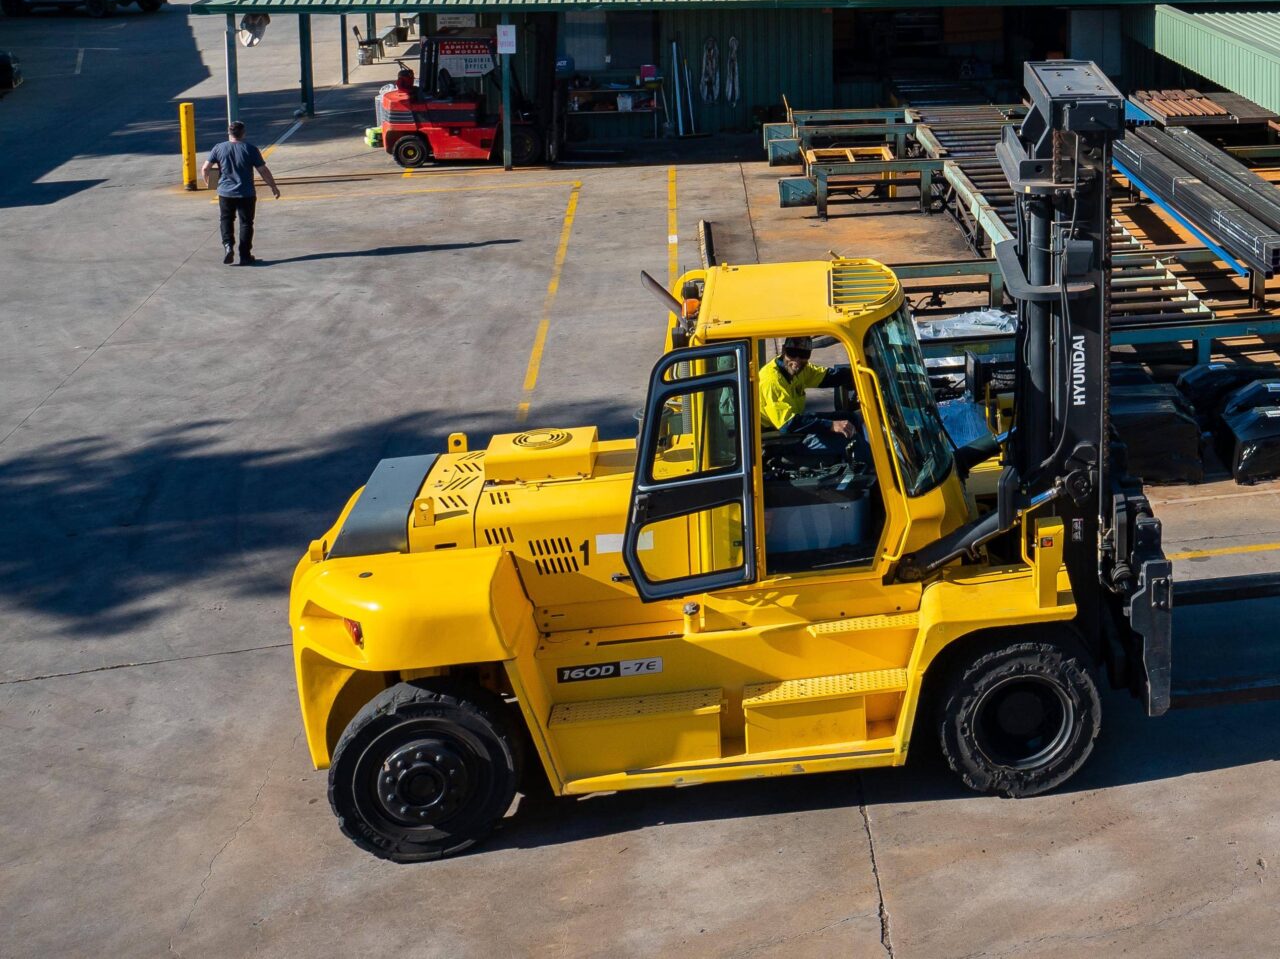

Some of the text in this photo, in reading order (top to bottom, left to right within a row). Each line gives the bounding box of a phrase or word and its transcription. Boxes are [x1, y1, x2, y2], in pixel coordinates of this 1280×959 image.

[1073, 335, 1086, 406] HYUNDAI
[579, 539, 590, 566] 1
[562, 664, 615, 681] 160D
